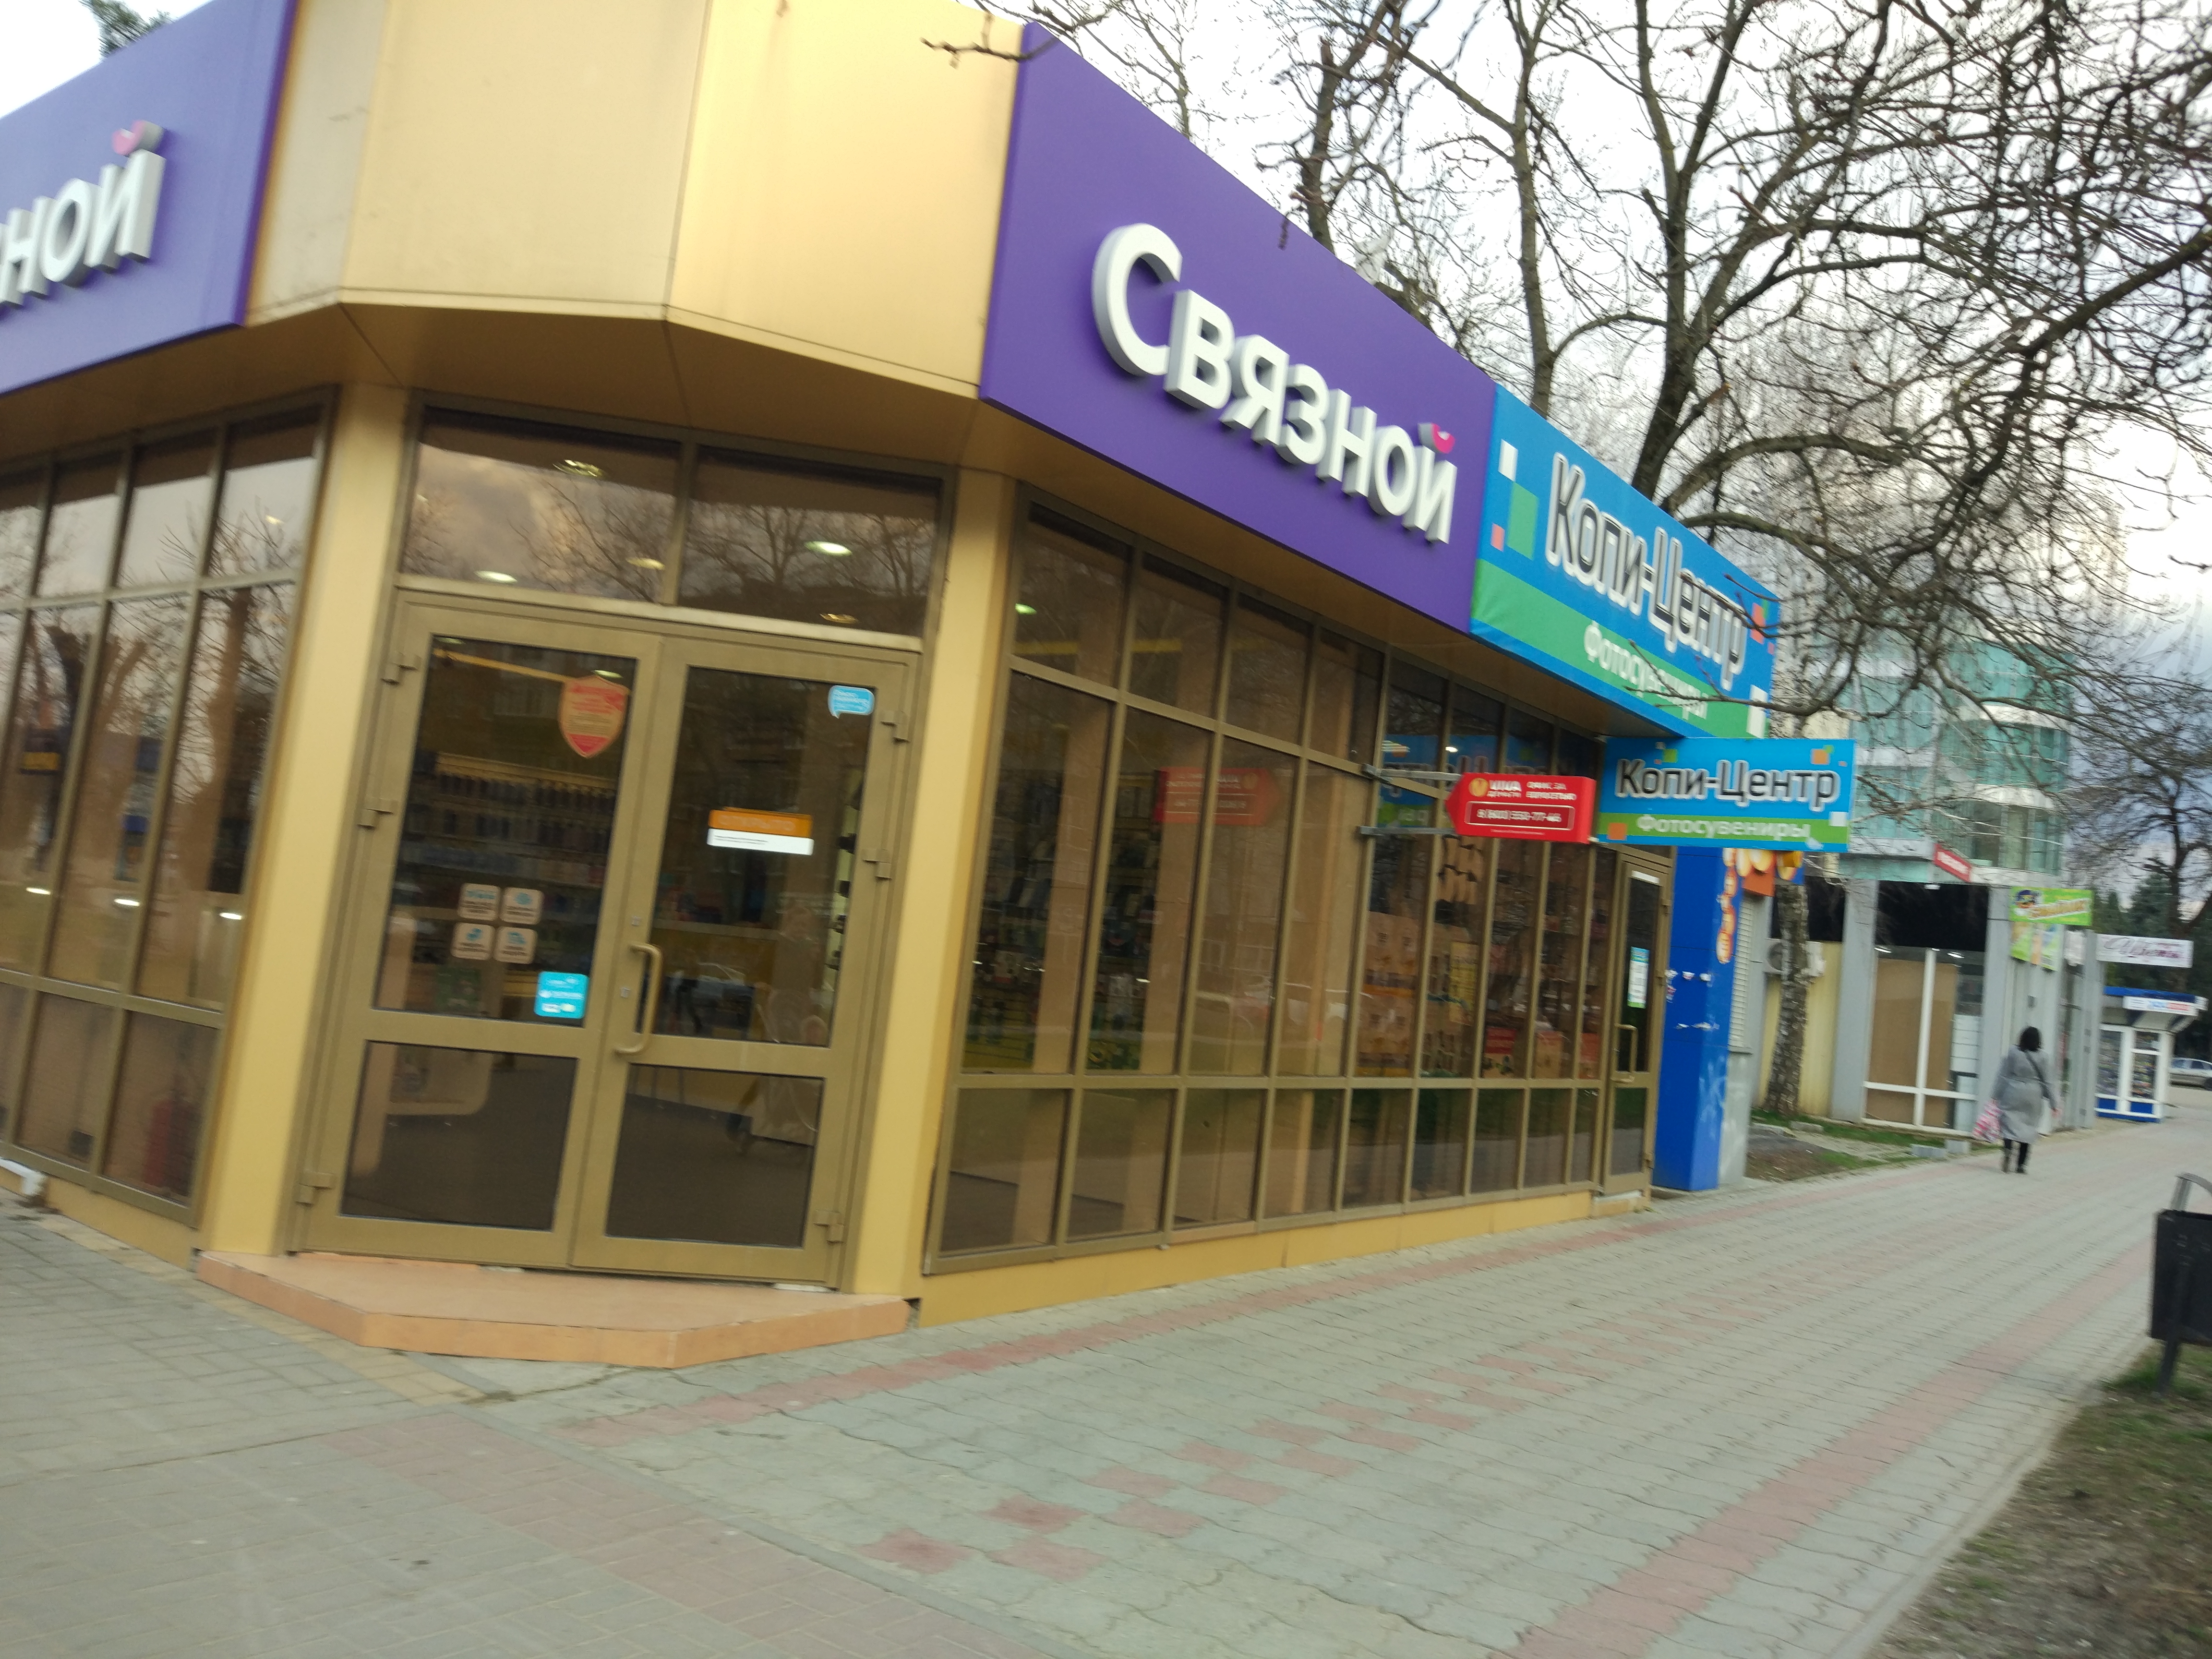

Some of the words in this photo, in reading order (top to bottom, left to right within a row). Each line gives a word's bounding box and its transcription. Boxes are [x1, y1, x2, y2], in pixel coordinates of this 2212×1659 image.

[0, 120, 166, 310] ной
[1092, 223, 1458, 544] Связной
[1545, 452, 1748, 691] Копи-Центр
[1615, 758, 1840, 812] Копи-Центр
[1637, 814, 1812, 841] Фотосувениры
